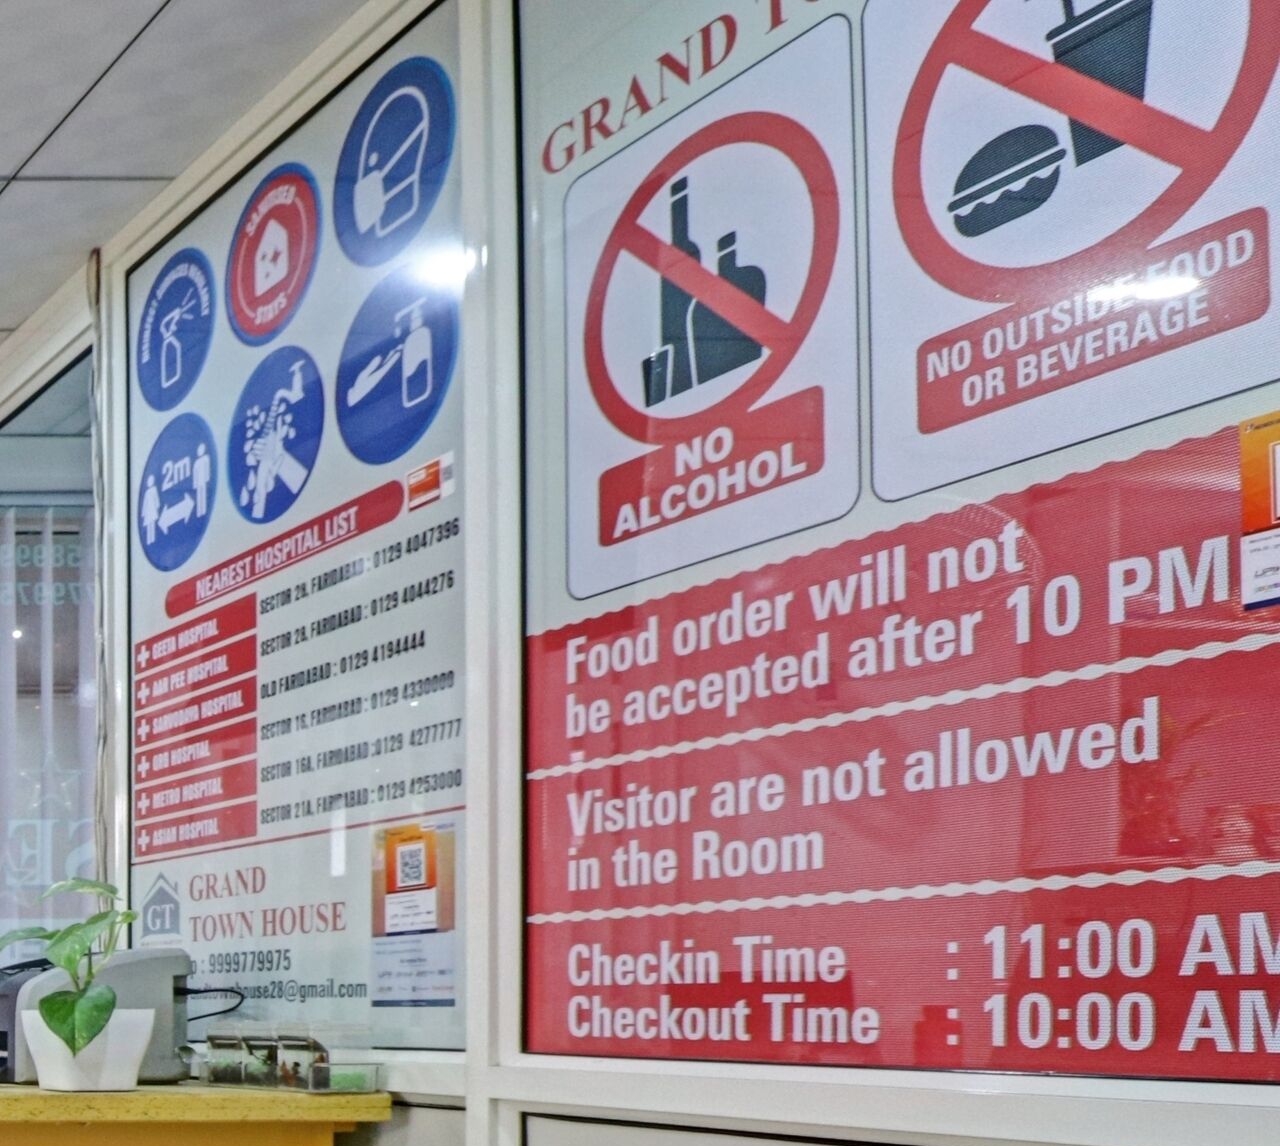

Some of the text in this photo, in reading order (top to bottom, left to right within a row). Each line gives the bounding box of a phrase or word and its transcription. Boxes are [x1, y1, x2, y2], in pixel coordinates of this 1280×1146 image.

[541, 13, 738, 174] GRAND
[926, 340, 972, 382] NO
[962, 287, 1210, 407] OR BEVERAGE
[161, 455, 191, 492] 2m
[675, 426, 733, 477] NO
[613, 442, 807, 539] ALCOHOL
[196, 506, 359, 601] NEAREST HOSPITAL LIST
[260, 588, 292, 615] SECTOR
[311, 558, 364, 593] FARIDABAD
[374, 542, 402, 568] 0129
[260, 631, 292, 656] SECTOR
[311, 605, 362, 636] FARIDABAD
[370, 591, 398, 616] 0129
[566, 518, 1025, 685] Food order will not
[178, 618, 219, 649] HOSPITAL
[565, 693, 611, 739] be
[623, 631, 829, 718] accepted
[848, 610, 983, 679] after
[1006, 573, 1080, 645] 10
[1108, 535, 1230, 625] PM
[186, 654, 229, 684] HOSPITAL
[260, 680, 277, 699] OLD
[279, 662, 331, 694] FARIDABAD
[340, 649, 369, 674] 0129
[372, 630, 426, 663] 4194444
[201, 690, 244, 719] HOSPITAL
[260, 718, 292, 741] SECTOR
[371, 686, 399, 710] 0129
[170, 740, 211, 766] HOSPITAL
[260, 761, 292, 783] SECTOR
[317, 741, 369, 770] FARIDABAD
[409, 718, 462, 747] 4277777
[567, 695, 1161, 837] Visitor are not allowed
[182, 776, 223, 802] HOSPITAL
[260, 801, 292, 824] SECTOR
[377, 780, 405, 803] 0129
[178, 817, 219, 841] HOSPITAL
[189, 866, 266, 901] GRAND
[567, 829, 825, 892] in the Room
[147, 903, 175, 931] GT
[189, 902, 347, 942] TOWN HOUSE
[208, 949, 292, 974] 9999779975
[567, 940, 720, 988] Checkin
[732, 933, 847, 983] Time
[983, 918, 1156, 981] 11:00
[1178, 912, 1280, 976] AM
[567, 995, 751, 1043] Checkout
[762, 997, 880, 1046] Time
[983, 991, 1156, 1051] 10:00
[1178, 989, 1280, 1053] AM
